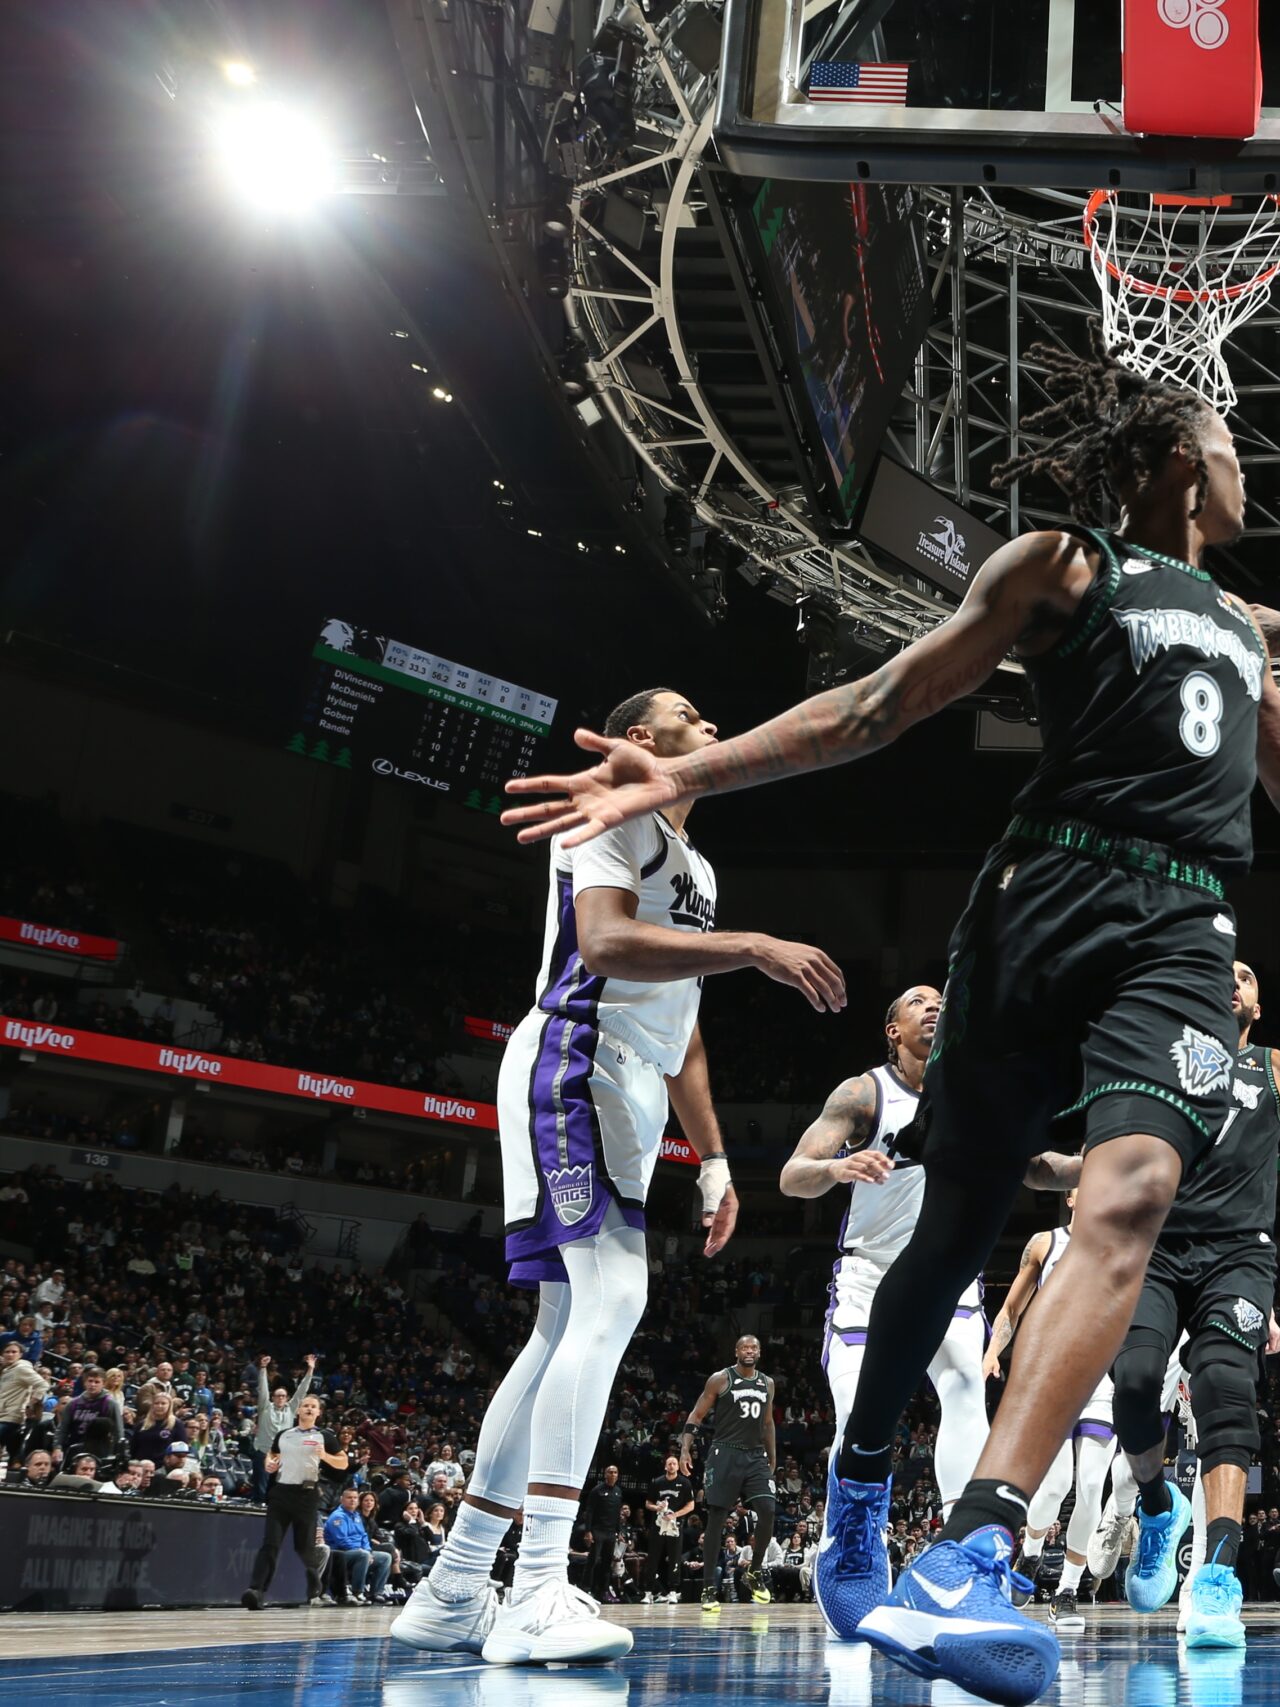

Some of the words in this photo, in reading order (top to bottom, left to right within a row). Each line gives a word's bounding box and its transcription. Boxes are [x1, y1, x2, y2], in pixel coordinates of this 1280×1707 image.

[918, 531, 945, 559] Treasure
[949, 552, 970, 575] Island
[387, 656, 405, 667] 41.2
[409, 663, 426, 675] 33.3
[432, 671, 449, 683] 56.2
[456, 681, 466, 689] 26
[478, 688, 487, 696] 14
[457, 670, 469, 679] REB
[478, 678, 492, 686] AST
[501, 685, 510, 693] TO
[540, 700, 552, 708] BLK
[330, 681, 376, 704] McDaniels
[521, 746, 533, 757] 1/4
[334, 669, 384, 692] DiVincenzo
[524, 735, 536, 745] 1/5
[428, 688, 441, 697] PTS
[443, 693, 456, 702] REB
[460, 699, 473, 708] AST
[518, 718, 543, 733] 3PM/A
[1178, 670, 1224, 757] 8
[319, 719, 350, 736] Randle
[323, 706, 354, 723] Gobert
[431, 742, 440, 752] 10
[327, 694, 359, 711] Hyland
[517, 758, 529, 768] 1/3
[394, 766, 450, 791] LEXUS
[20, 923, 80, 949] HyVee
[5, 1021, 75, 1050] HyVee
[159, 1049, 222, 1075] HyVee
[297, 1074, 355, 1099] HyVee
[424, 1096, 476, 1120] HyVee
[659, 1139, 690, 1158] Vee
[84, 1153, 110, 1167] 136
[739, 1401, 761, 1419] 30
[27, 1515, 94, 1546] IMAGINE
[96, 1519, 123, 1549] THE
[20, 1558, 49, 1589] ALL
[52, 1559, 70, 1589] IN
[72, 1559, 102, 1589] ONE
